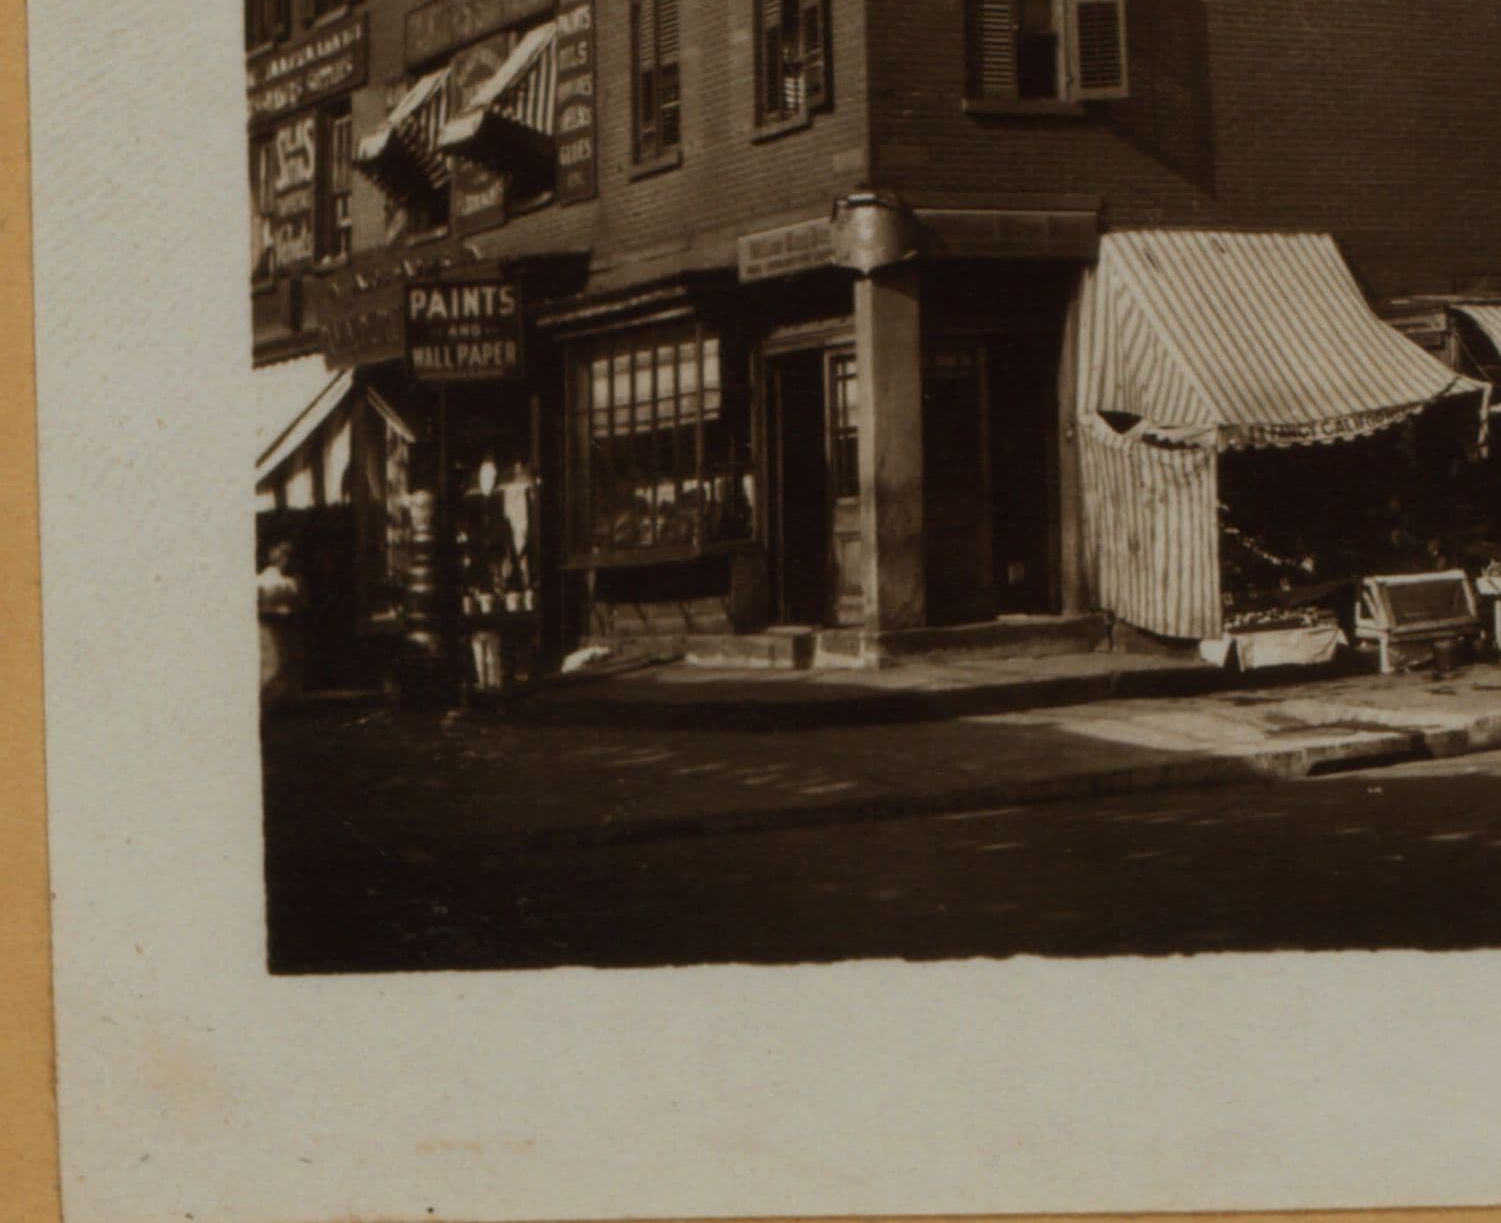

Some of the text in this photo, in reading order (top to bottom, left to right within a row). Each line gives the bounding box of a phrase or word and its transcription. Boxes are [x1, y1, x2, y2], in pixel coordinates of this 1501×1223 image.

[409, 285, 516, 321] PAINTS
[447, 323, 481, 338] AND
[412, 340, 517, 370] WALL PAPER
